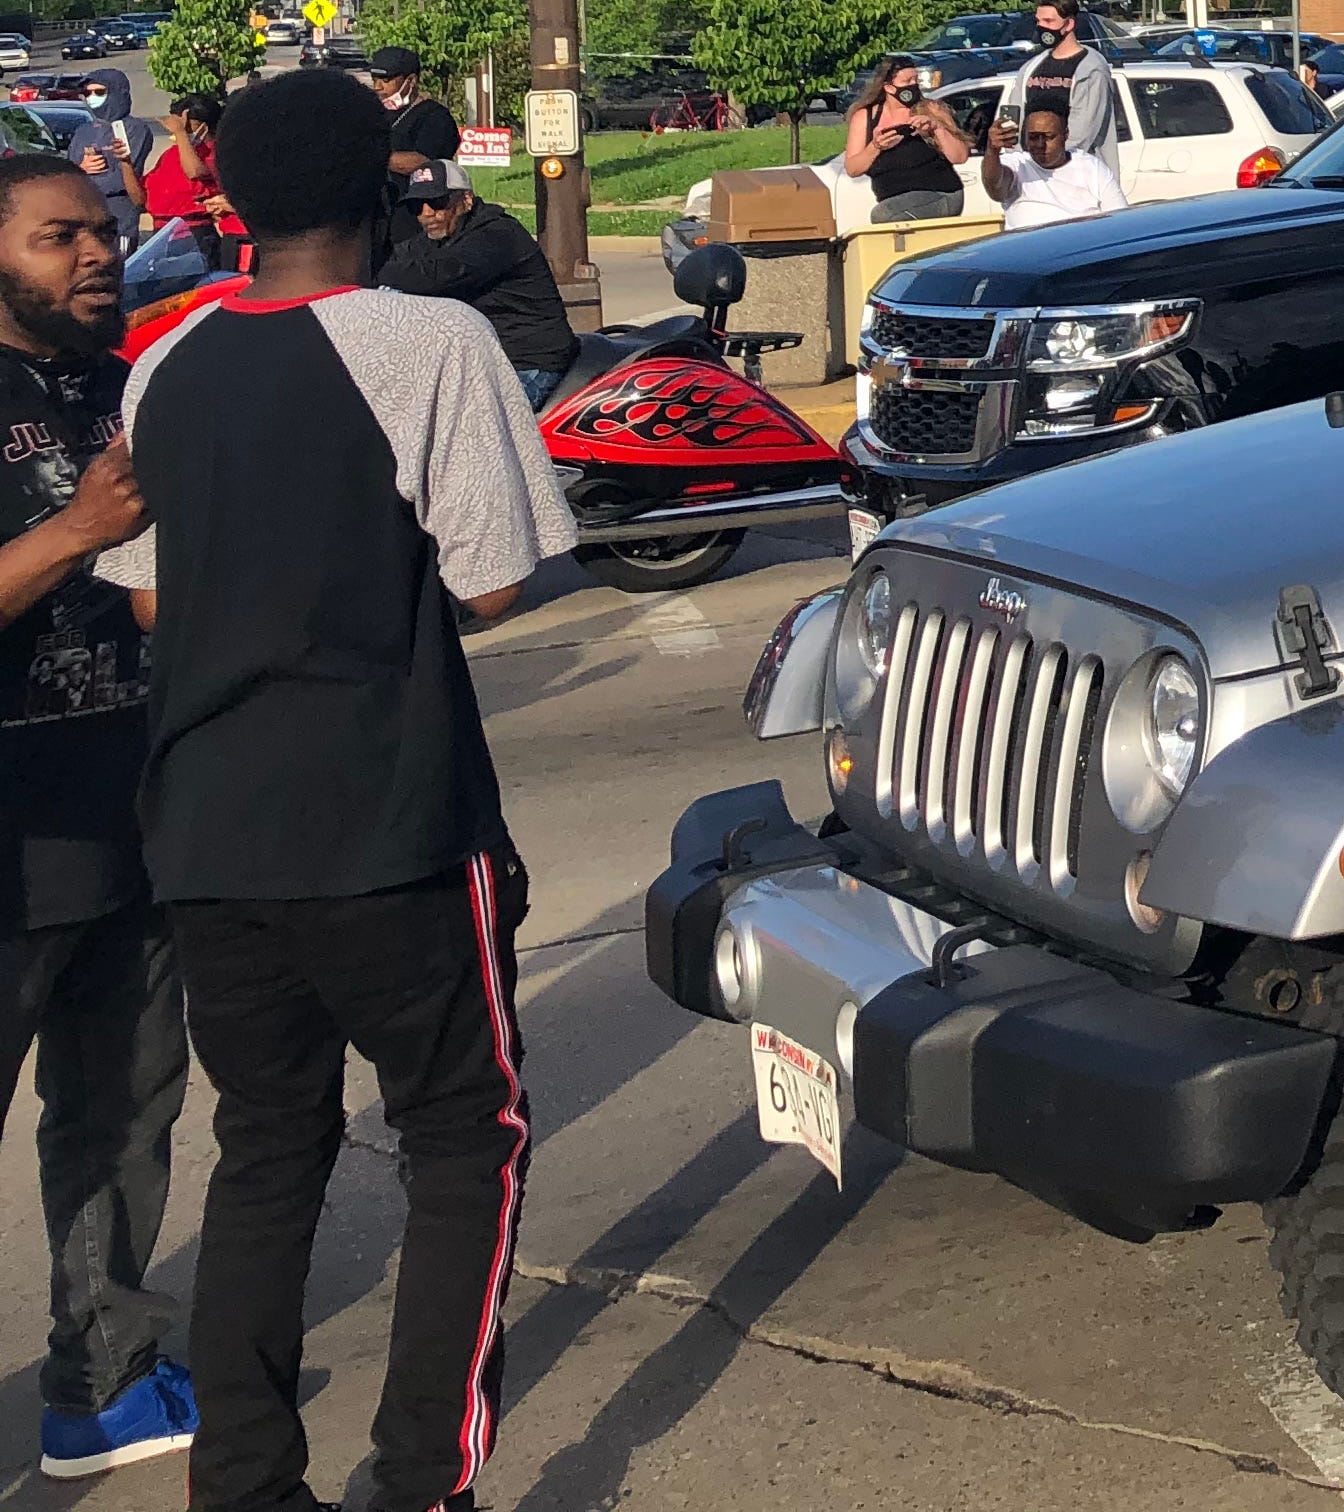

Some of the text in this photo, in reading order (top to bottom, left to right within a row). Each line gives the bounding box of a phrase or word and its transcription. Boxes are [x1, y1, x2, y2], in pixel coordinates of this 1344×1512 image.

[462, 129, 510, 142] Come
[460, 142, 510, 155] On In!
